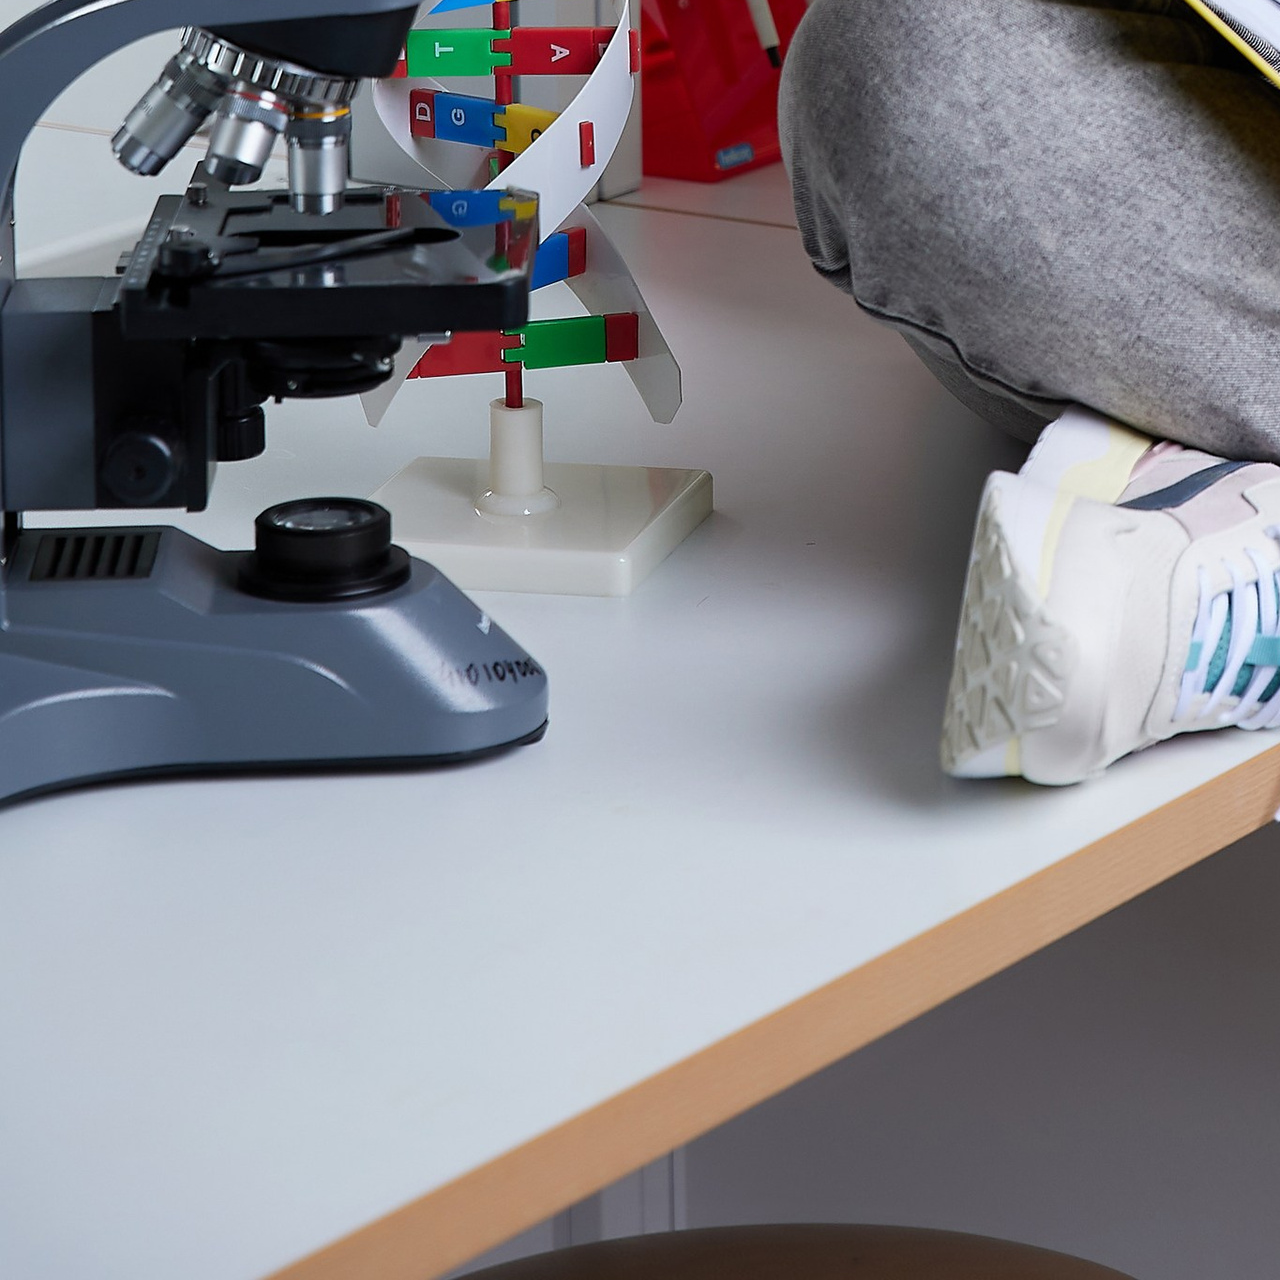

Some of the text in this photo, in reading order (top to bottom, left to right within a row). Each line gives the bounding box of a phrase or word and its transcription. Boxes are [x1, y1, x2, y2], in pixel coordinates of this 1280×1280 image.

[434, 41, 454, 57] T
[550, 43, 570, 62] A
[451, 108, 466, 126] G
